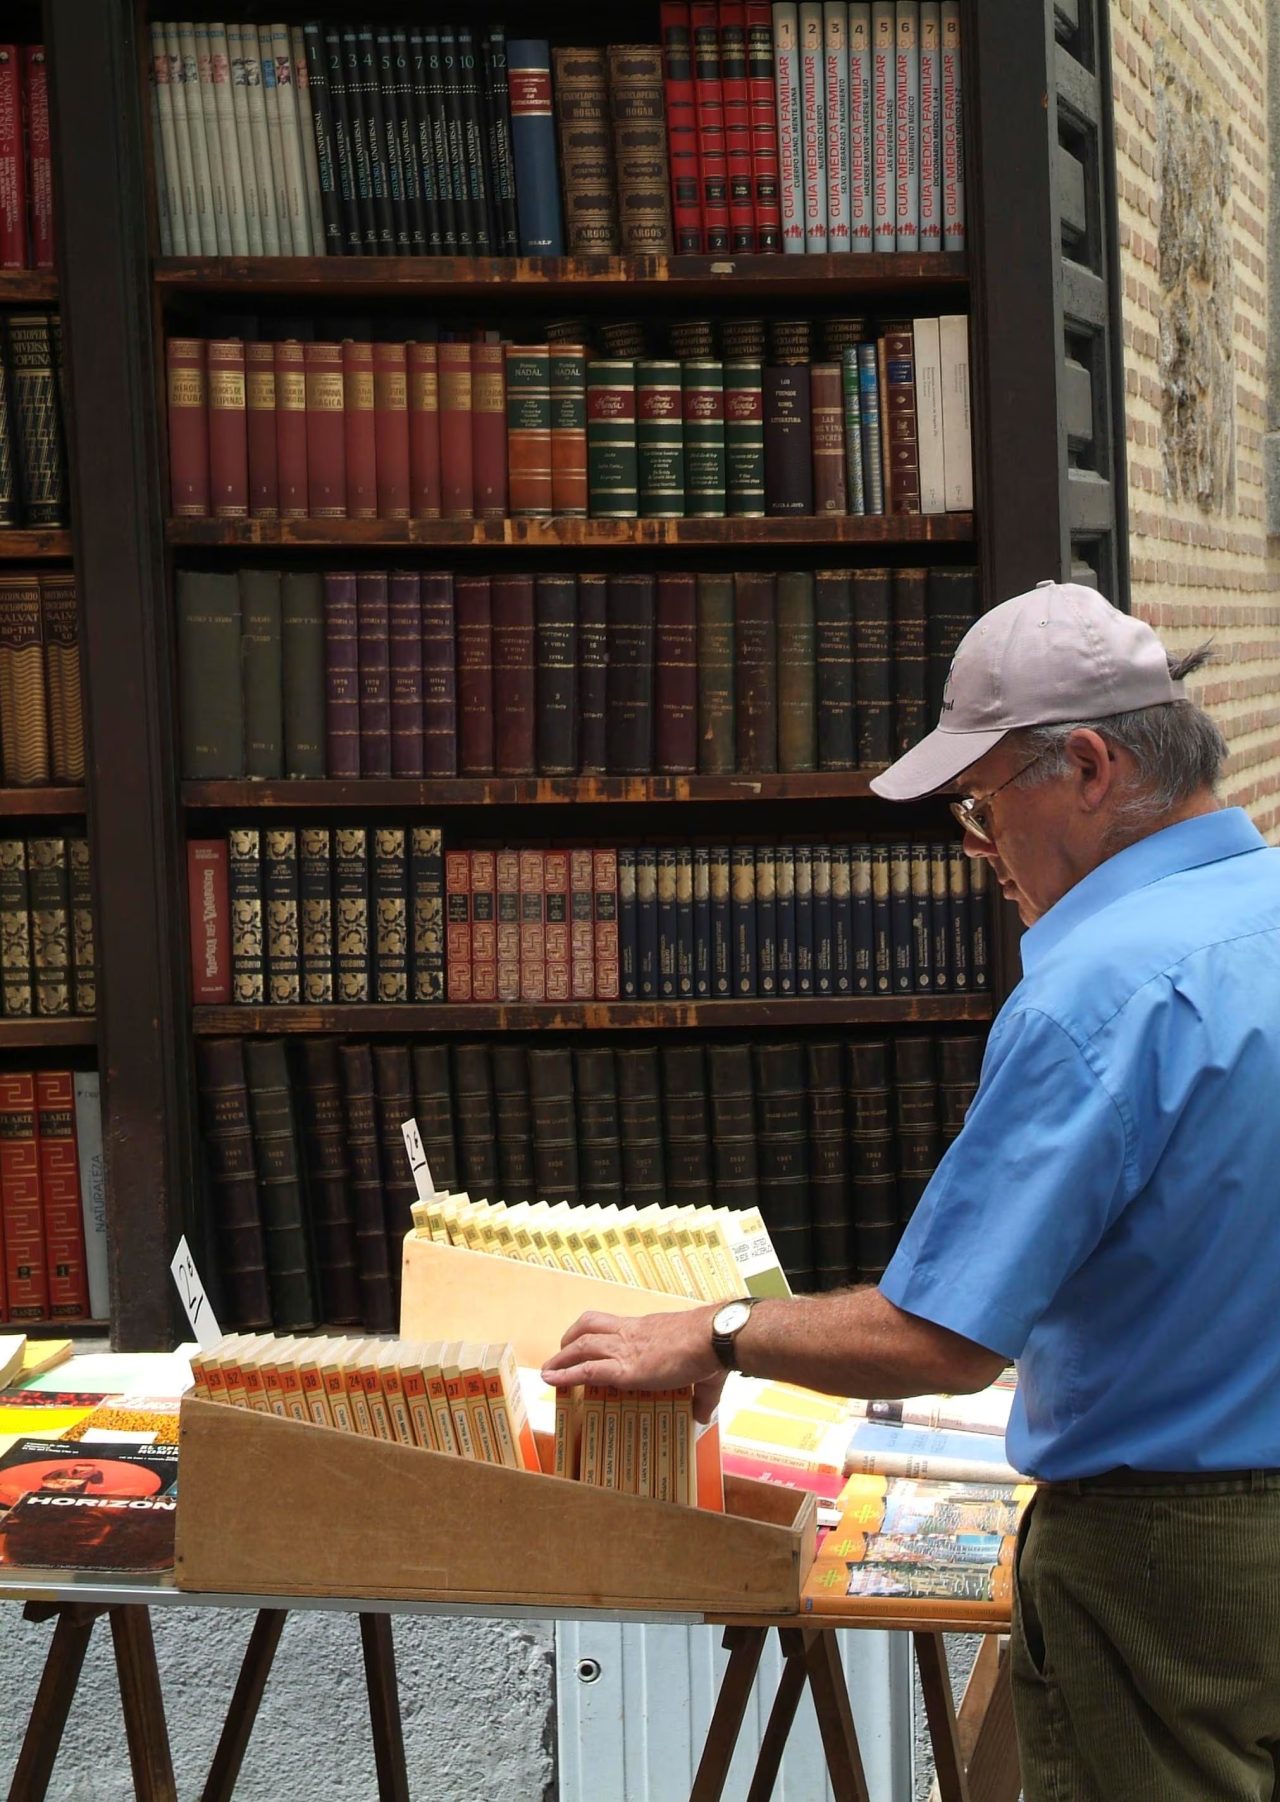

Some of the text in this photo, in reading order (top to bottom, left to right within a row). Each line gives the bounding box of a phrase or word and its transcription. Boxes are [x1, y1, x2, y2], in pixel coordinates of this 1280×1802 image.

[781, 25, 789, 33] 1
[808, 24, 816, 33] 2
[831, 24, 839, 33] 3
[855, 25, 863, 34] 4
[880, 23, 888, 31] 5
[901, 23, 909, 32] 6
[926, 25, 934, 33] 7
[947, 23, 956, 32] 8
[311, 47, 316, 60] 1
[331, 55, 341, 69] 2
[348, 55, 357, 67] 3
[363, 54, 372, 66] 4
[382, 56, 390, 68] 5
[396, 54, 406, 67] 6
[415, 56, 424, 70] 7
[430, 55, 439, 68] 8
[444, 55, 454, 68] 9
[460, 55, 474, 69] 10
[492, 54, 506, 68] 12
[779, 57, 791, 121] FAMILIAR
[805, 56, 816, 120] FAMILIAR
[828, 56, 838, 120] FAMILIAR
[851, 57, 861, 121] FAMILIAR
[876, 55, 886, 119] FAMILIAR
[897, 55, 907, 119] FAMILIAR
[922, 57, 932, 121] FAMILIAR
[944, 55, 955, 119] FAMILIAR
[315, 111, 326, 155] UNIVERSAL
[369, 117, 378, 161] UNIVERSAL
[336, 120, 346, 163] UNIVERSAL
[353, 118, 364, 161] UNIVERSAL
[386, 120, 397, 164] UNIVERSAL
[401, 119, 411, 162] UNIVERSAL
[419, 121, 429, 164] UNIVERSAL
[434, 120, 444, 163] UNIVERSAL
[449, 120, 459, 164] UNIVERSAL
[466, 119, 476, 163] UNIVERSAL
[581, 229, 610, 238] ARGOS
[632, 229, 662, 237] ARGOS
[688, 239, 692, 247] 1
[716, 239, 722, 247] 2
[741, 236, 746, 245] 3
[766, 235, 772, 245] 4
[515, 369, 543, 377] NADAL
[11, 1114, 33, 1123] ARTE
[50, 1113, 71, 1121] ARTE
[96, 1155, 105, 1233] NATURALEZA
[209, 1375, 220, 1386] 53
[227, 1373, 238, 1384] 52
[305, 1376, 316, 1387] 38
[350, 1376, 360, 1387] 24
[408, 1379, 418, 1391] 77
[448, 1384, 458, 1395] 37
[489, 1380, 498, 1392] 47
[607, 1477, 612, 1487] DE
[27, 1497, 177, 1511] HORIZON
